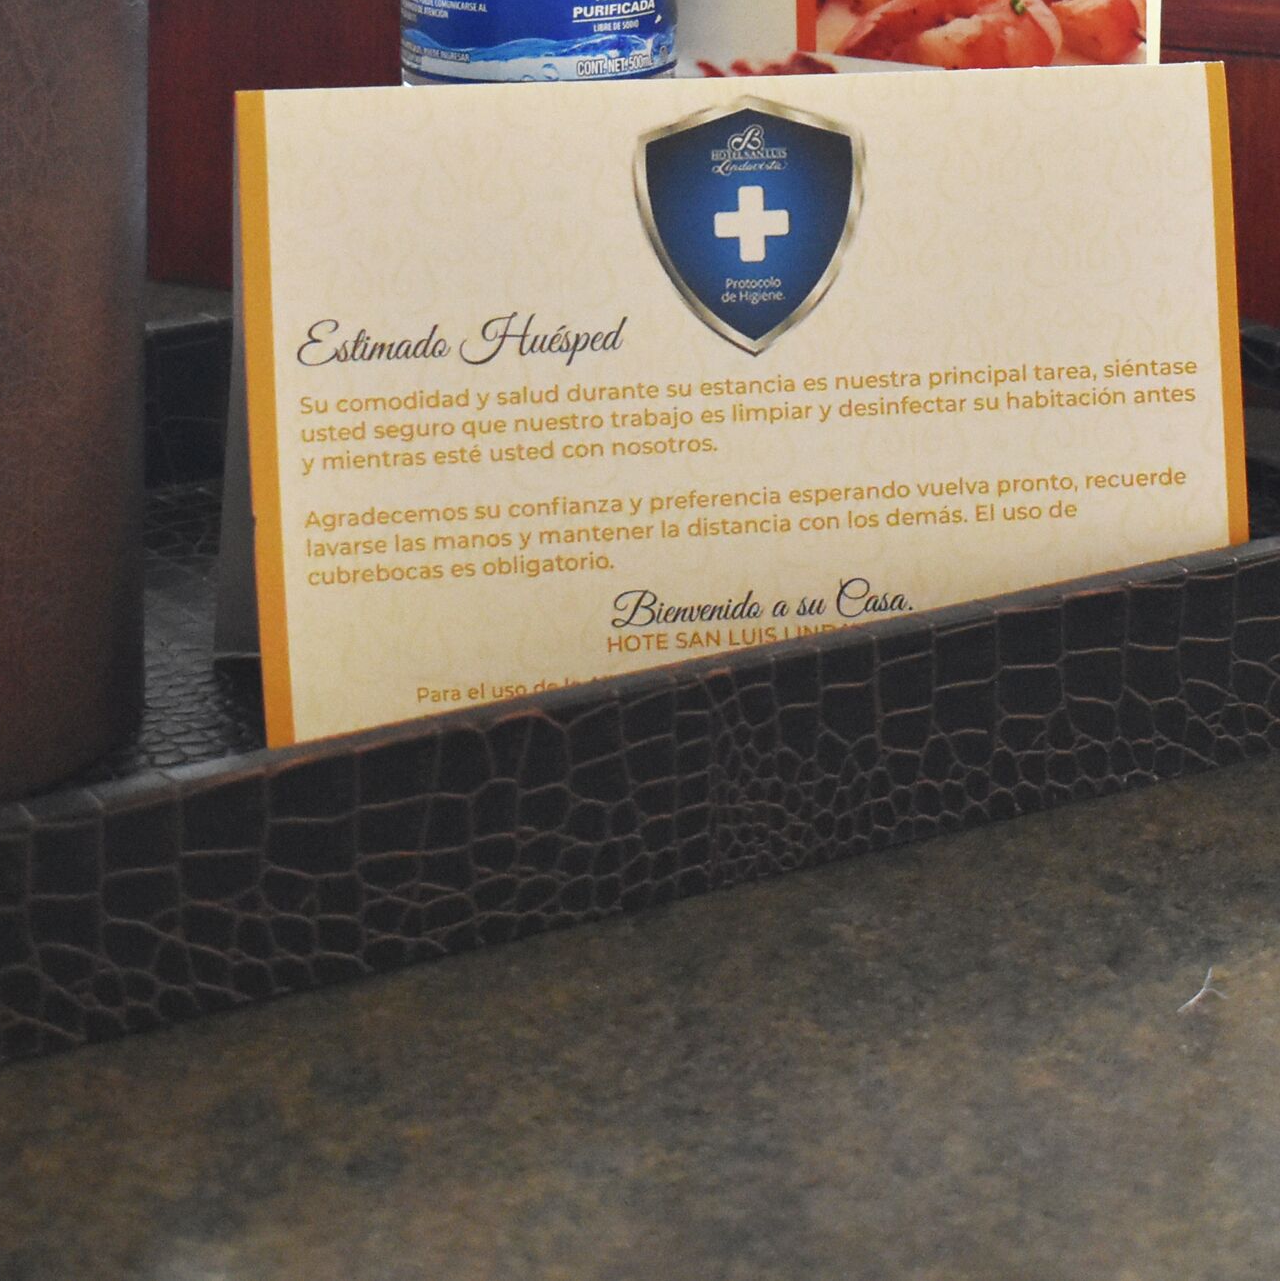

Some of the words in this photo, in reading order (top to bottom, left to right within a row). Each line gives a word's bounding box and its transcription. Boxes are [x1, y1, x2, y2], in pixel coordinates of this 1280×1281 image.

[721, 292, 736, 303] de
[726, 276, 781, 289] Protocolo
[297, 319, 451, 366] Estimado
[460, 312, 628, 367] Huésped
[300, 396, 329, 415] Su
[336, 388, 470, 415] comodidad
[477, 393, 490, 411] y
[497, 384, 559, 405] salud
[567, 383, 659, 402] durante
[667, 383, 692, 398] su
[699, 375, 796, 398] estancia
[803, 377, 828, 391] es
[835, 371, 921, 389] nuestra
[929, 364, 1027, 390] principal
[1033, 365, 1097, 381] tarea,
[1104, 359, 1197, 378] siéntase
[301, 422, 365, 443] usted
[375, 423, 455, 442] seguro
[462, 420, 506, 439] que
[515, 414, 604, 432] nuestro
[611, 409, 693, 431] trabajo
[700, 409, 725, 424] es
[732, 402, 813, 424] limpiar
[819, 404, 832, 423] y
[839, 396, 966, 417] desinfectar
[974, 397, 1000, 411] su
[1007, 388, 1126, 409] habitación
[1134, 386, 1196, 405] antes
[302, 458, 314, 475] y
[323, 450, 426, 470] mientras
[433, 445, 481, 466] esté
[490, 441, 555, 462] usted
[562, 443, 604, 459] con
[611, 437, 718, 456] nosotros.
[304, 506, 468, 532] Agradecemos
[475, 504, 501, 520] su
[508, 496, 624, 518] confianza
[630, 498, 642, 516] y
[650, 487, 781, 514] preferencia
[789, 480, 911, 506] esperando
[917, 477, 989, 496] vuelva
[997, 474, 1078, 497] pronto,
[1086, 466, 1186, 489] recuerde
[307, 539, 387, 558] lavarse
[395, 534, 426, 552] las
[434, 533, 512, 550] manos
[520, 532, 531, 550] y
[540, 526, 653, 543] mantener
[661, 520, 680, 538] la
[686, 514, 791, 537] distancia
[799, 516, 839, 531] con
[848, 511, 879, 528] los
[886, 506, 967, 527] demás.
[976, 504, 995, 522] El
[1003, 506, 1043, 521] uso
[1049, 500, 1077, 518] de
[308, 564, 444, 586] cubrebocas
[451, 563, 476, 577] es
[483, 552, 614, 578] obligatorio.
[612, 589, 763, 628] Bienvenido
[772, 600, 789, 617] a
[796, 595, 827, 617] su
[836, 577, 914, 618] Casa.
[607, 633, 668, 653] HOTE
[676, 630, 720, 650] SAN
[728, 626, 778, 647] LUIS
[417, 687, 462, 703] Para
[467, 682, 485, 700] el
[492, 684, 528, 699] uso
